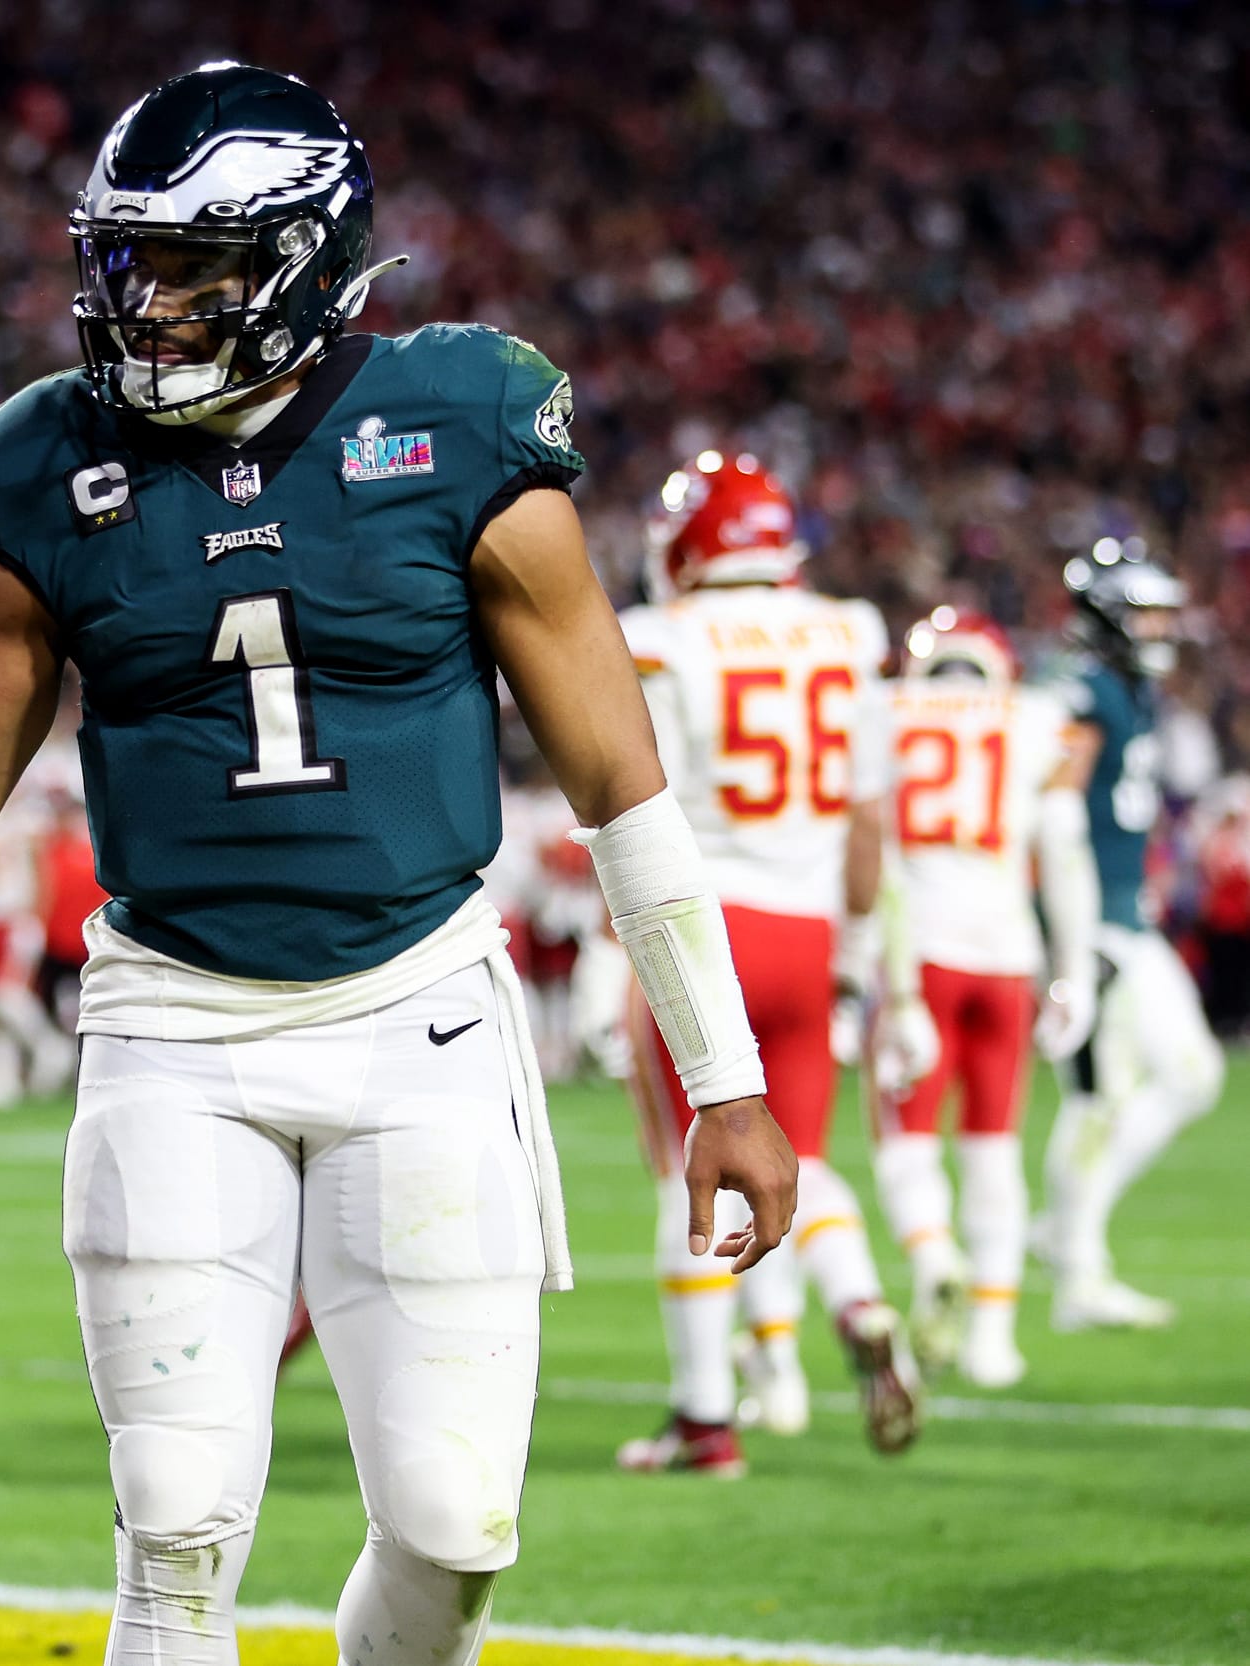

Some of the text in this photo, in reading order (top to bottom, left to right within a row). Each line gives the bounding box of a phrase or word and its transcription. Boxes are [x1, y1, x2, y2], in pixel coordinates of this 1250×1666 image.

[345, 433, 431, 470] LVII
[356, 465, 425, 476] SUPER BOWL
[70, 461, 130, 516] C
[229, 479, 256, 499] NFL
[202, 522, 285, 563] EAGLES
[209, 593, 338, 792] 1
[717, 665, 854, 821] 56
[896, 727, 1006, 856] 21
